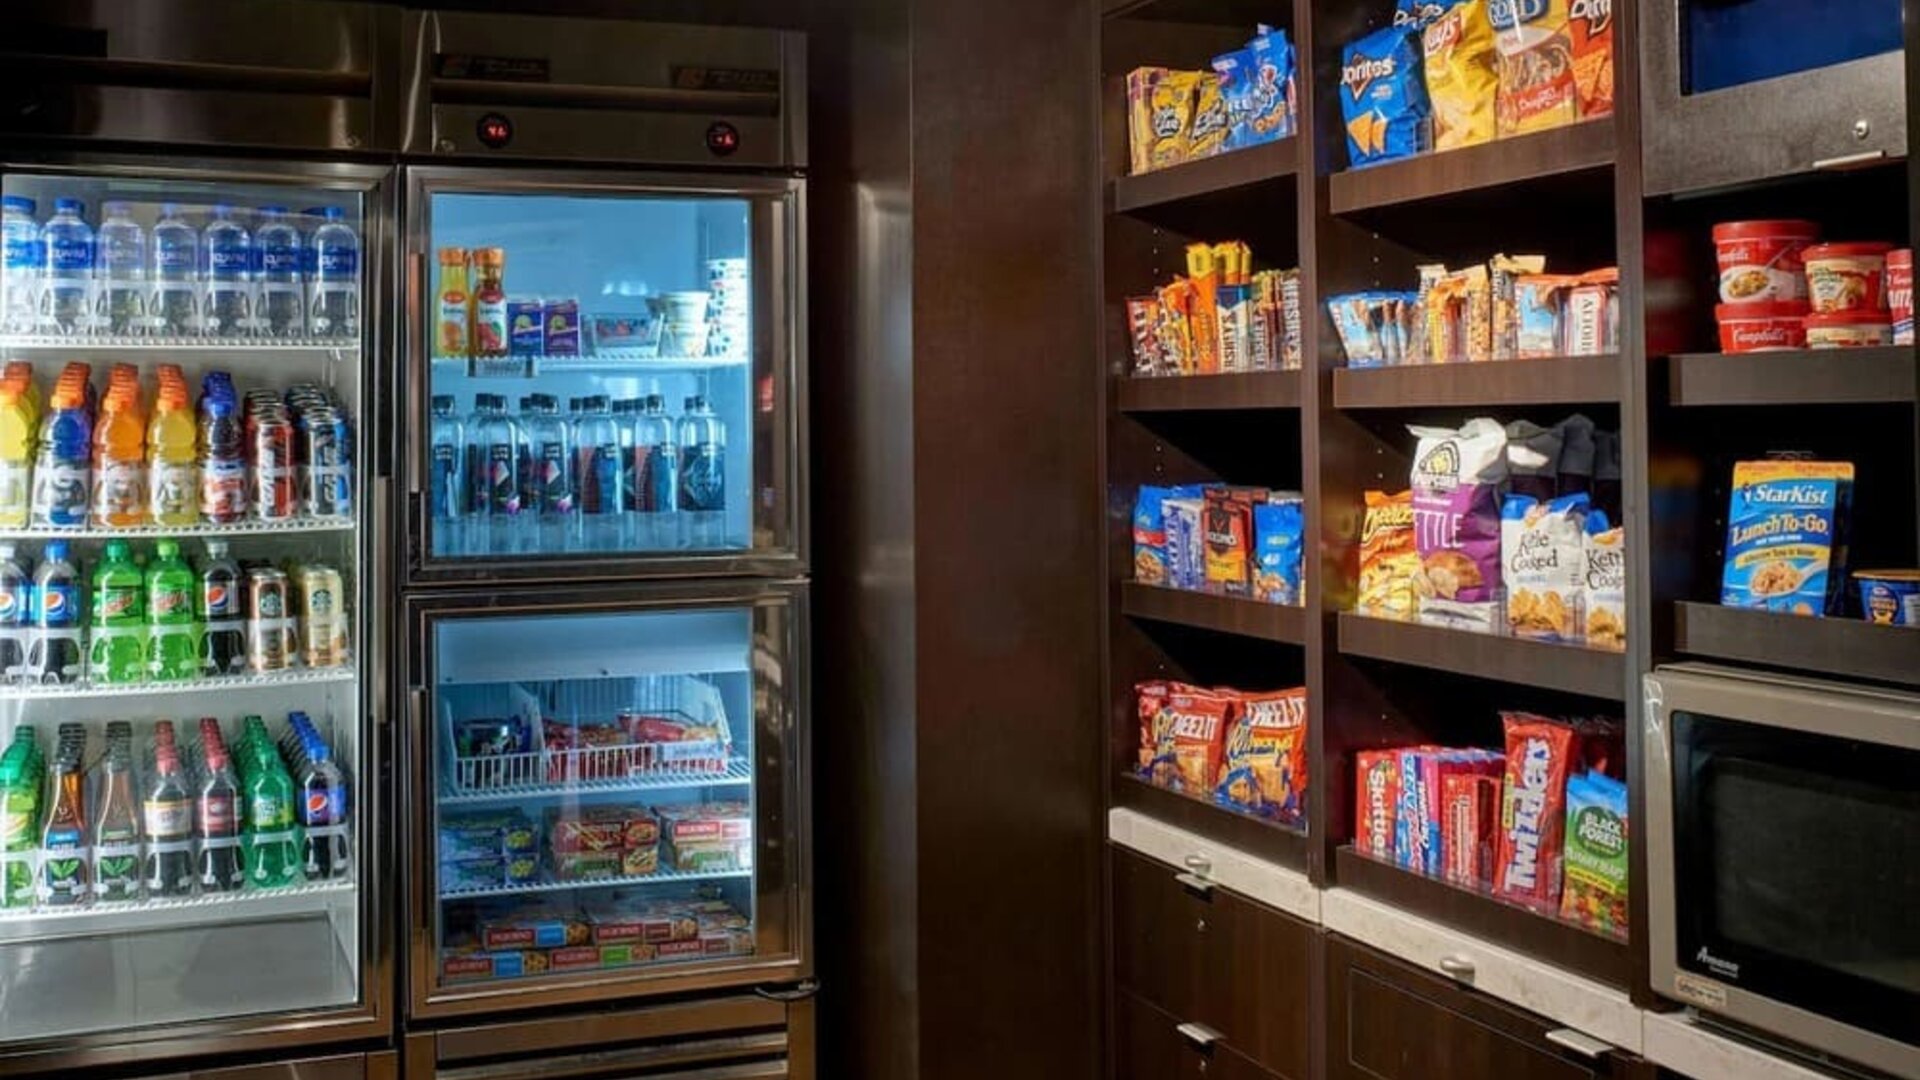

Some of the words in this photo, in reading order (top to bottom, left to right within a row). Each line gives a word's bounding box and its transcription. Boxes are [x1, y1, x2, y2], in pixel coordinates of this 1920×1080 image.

[1753, 484, 1828, 504] StarKist
[1732, 513, 1781, 546] Lunch
[1504, 738, 1551, 892] Twizzlers
[1585, 812, 1622, 836] BLACK
[1579, 824, 1622, 850] FOREST
